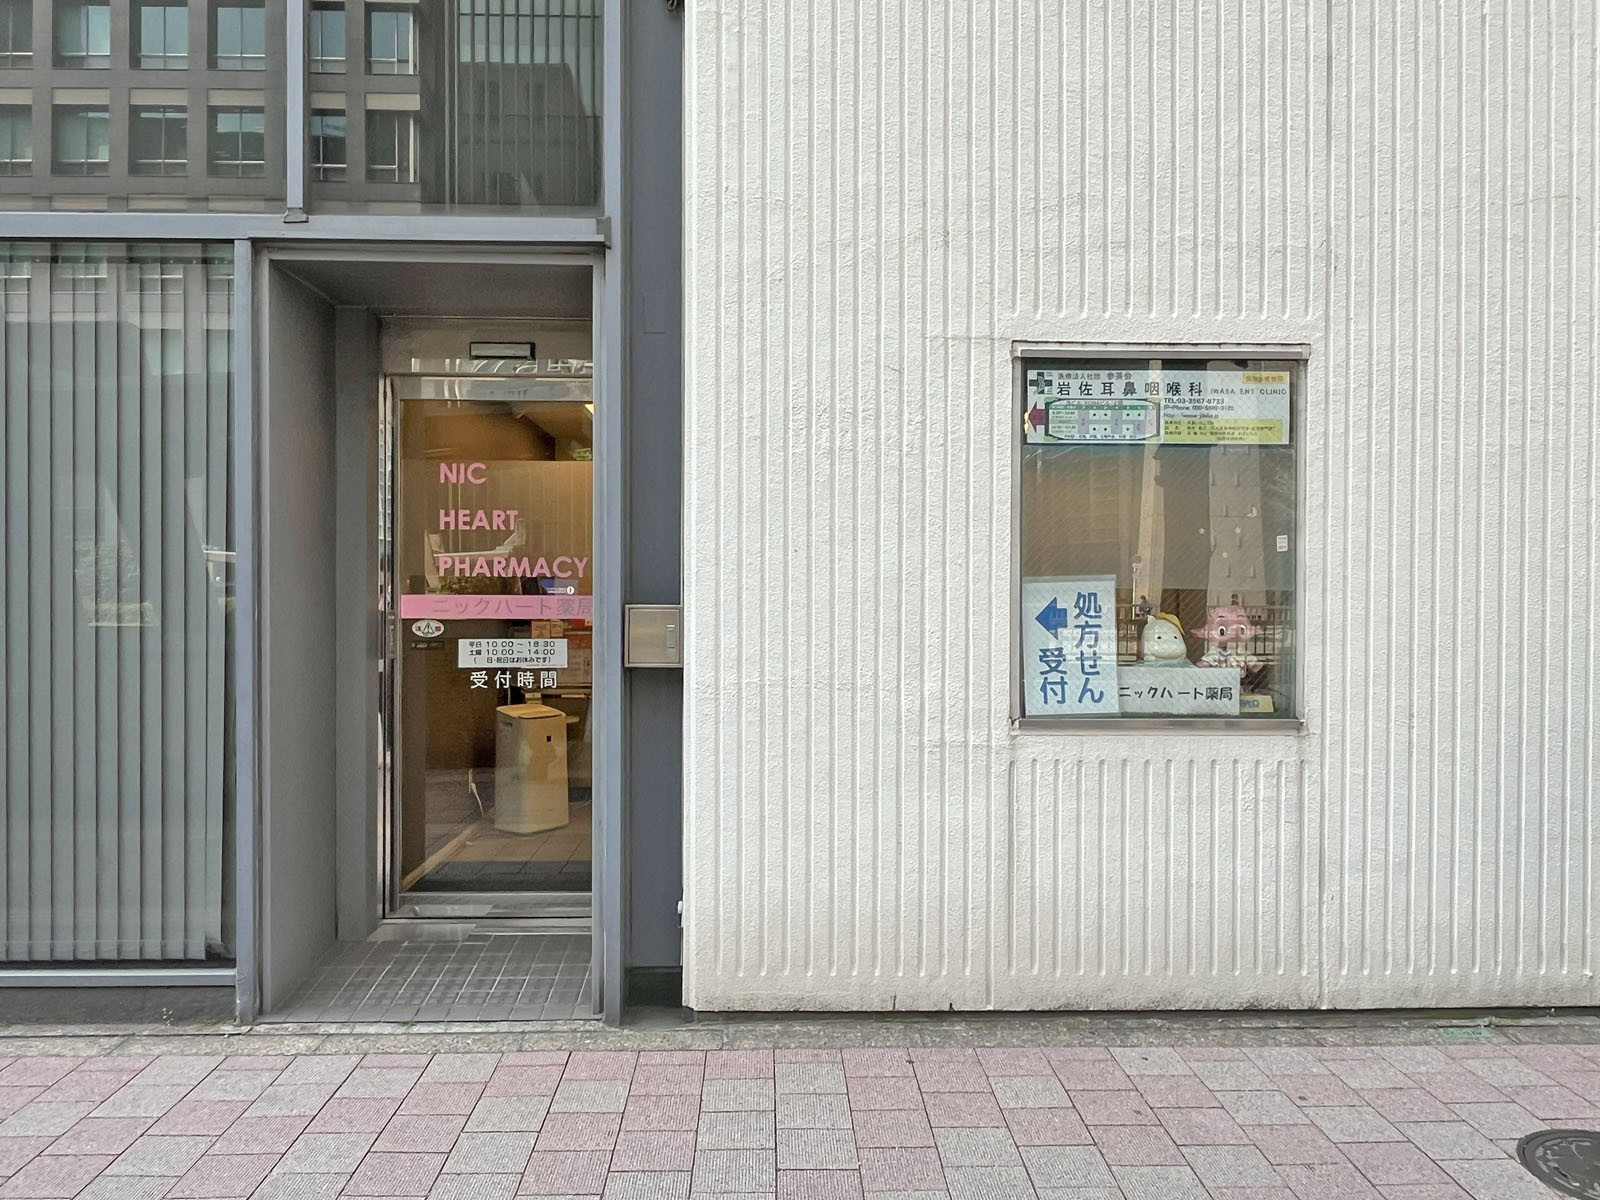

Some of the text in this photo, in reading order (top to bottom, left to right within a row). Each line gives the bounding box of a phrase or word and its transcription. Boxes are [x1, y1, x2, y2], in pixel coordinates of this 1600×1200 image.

[1056, 380, 1203, 397] 岩佐耳鼻咽喉科
[1210, 388, 1287, 396] IWASA ENT CLINIC
[439, 462, 487, 485] NIC
[439, 509, 519, 531] HEART
[438, 556, 589, 578] PHARMACY
[431, 598, 593, 616] ニックハート薬局
[1073, 591, 1105, 704] 処方せん
[470, 670, 558, 690] 受付時間
[1038, 646, 1068, 705] 受付
[1119, 686, 1233, 701] ニックハート薬局
